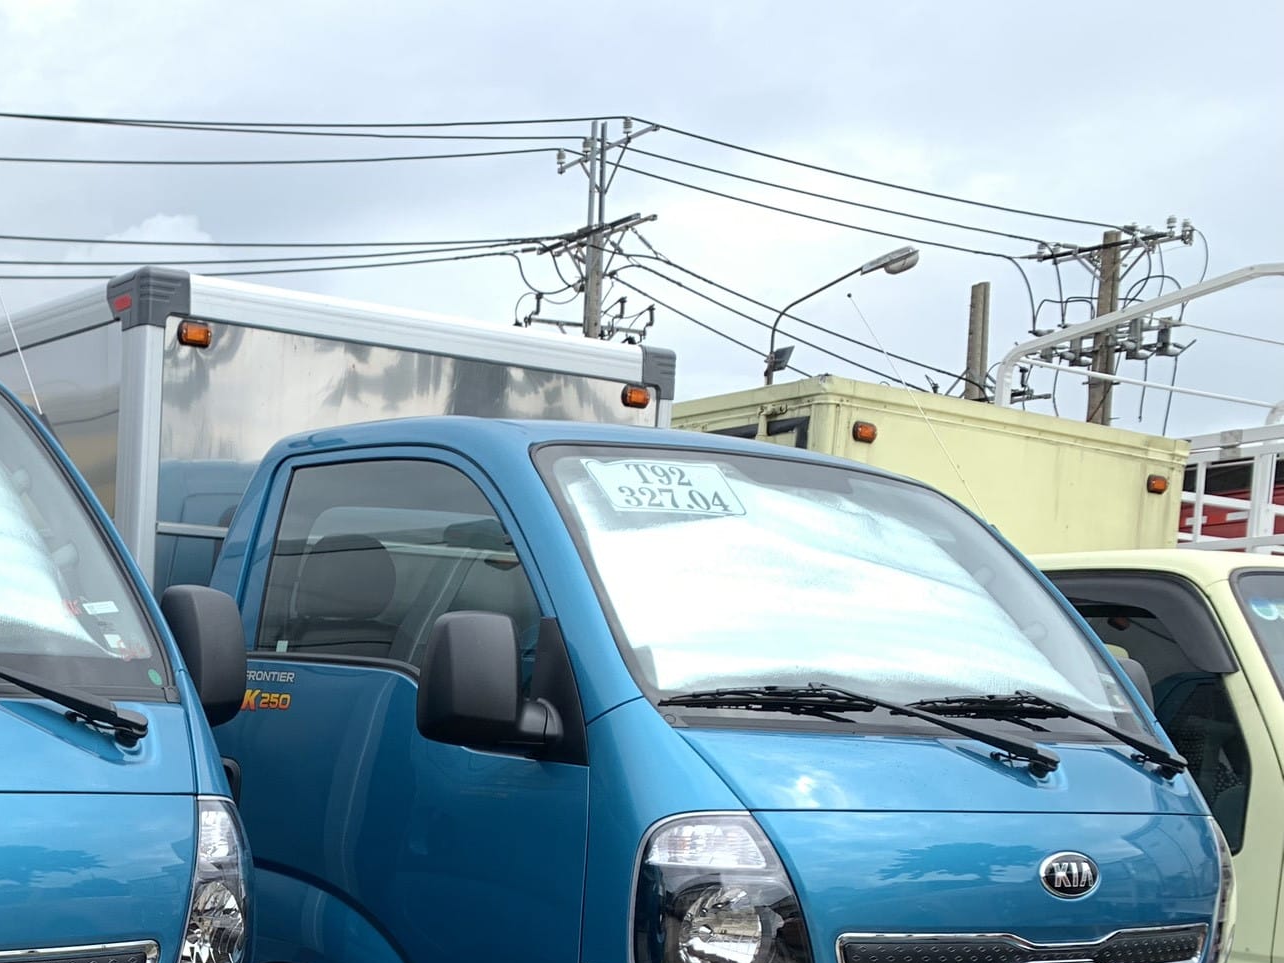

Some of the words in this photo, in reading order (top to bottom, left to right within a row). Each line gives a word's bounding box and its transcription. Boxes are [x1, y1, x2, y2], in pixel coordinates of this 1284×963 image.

[626, 463, 693, 487] T92
[618, 486, 733, 513] 327.04
[1052, 862, 1094, 888] KIA
